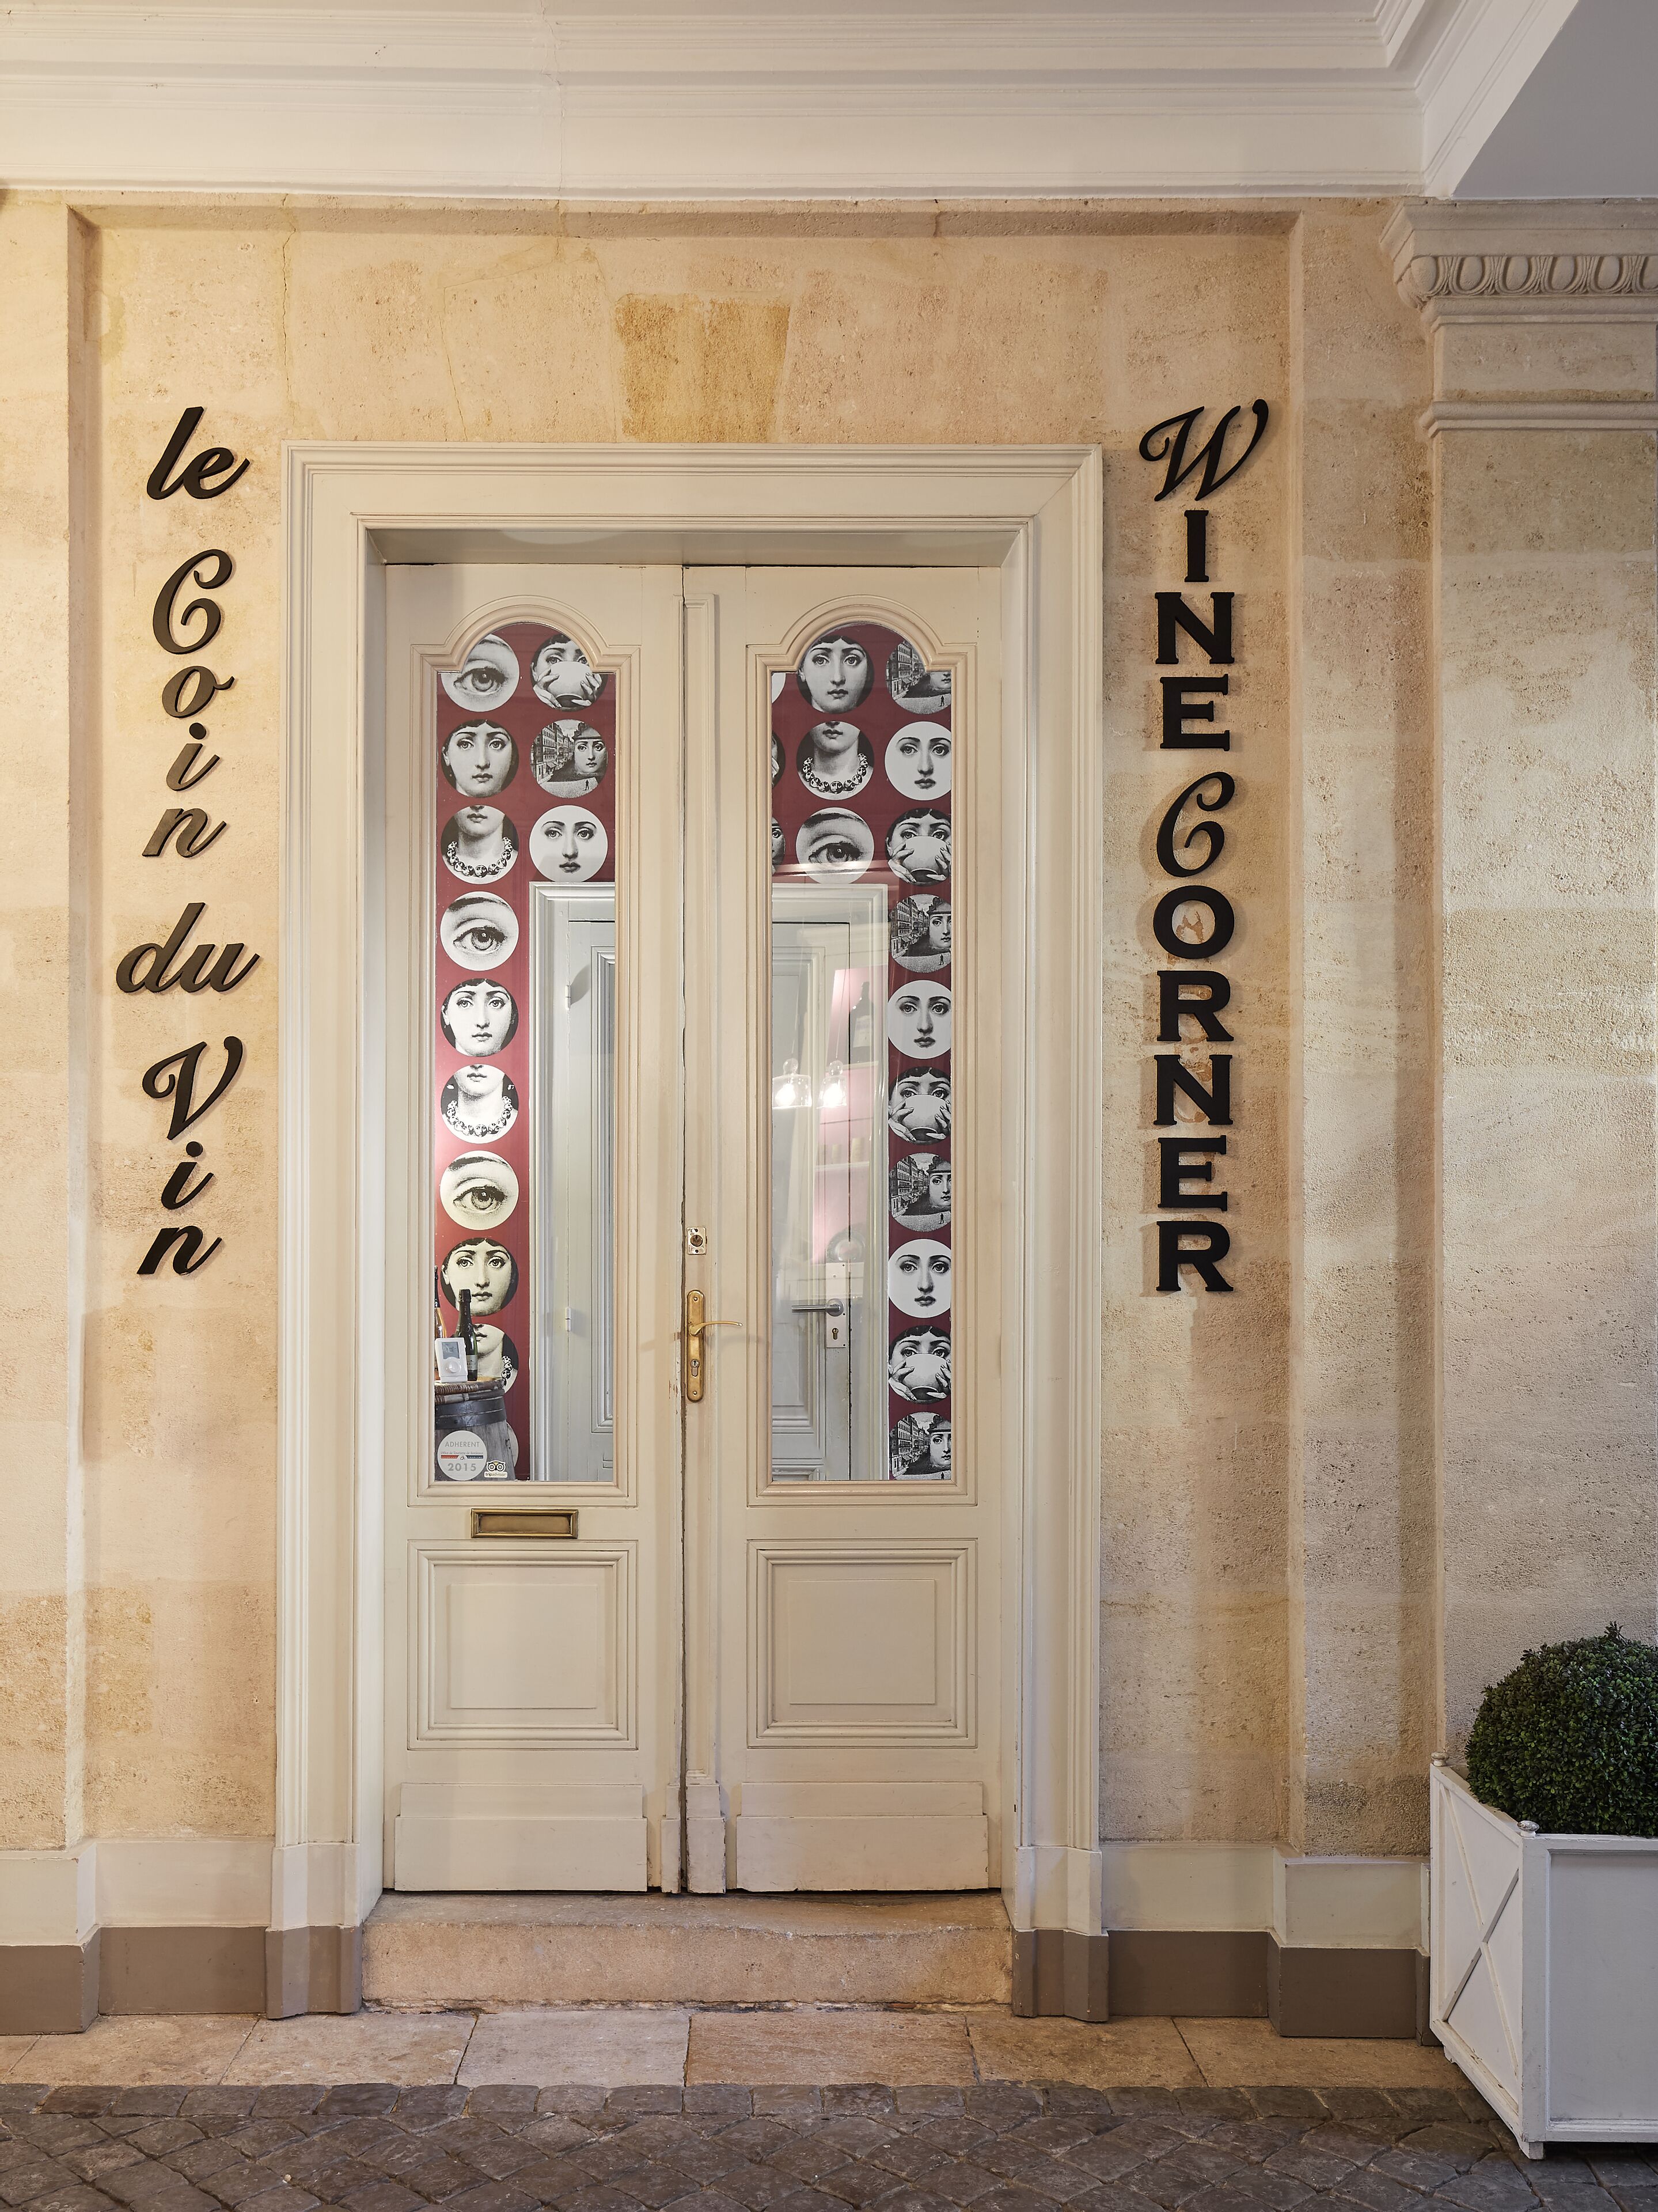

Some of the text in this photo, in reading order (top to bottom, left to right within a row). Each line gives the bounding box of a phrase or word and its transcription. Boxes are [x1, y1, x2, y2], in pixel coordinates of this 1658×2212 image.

[116, 406, 260, 1275] le Coin du Vin
[1139, 399, 1269, 1292] WINE CORNER
[447, 1463, 476, 1471] 2015
